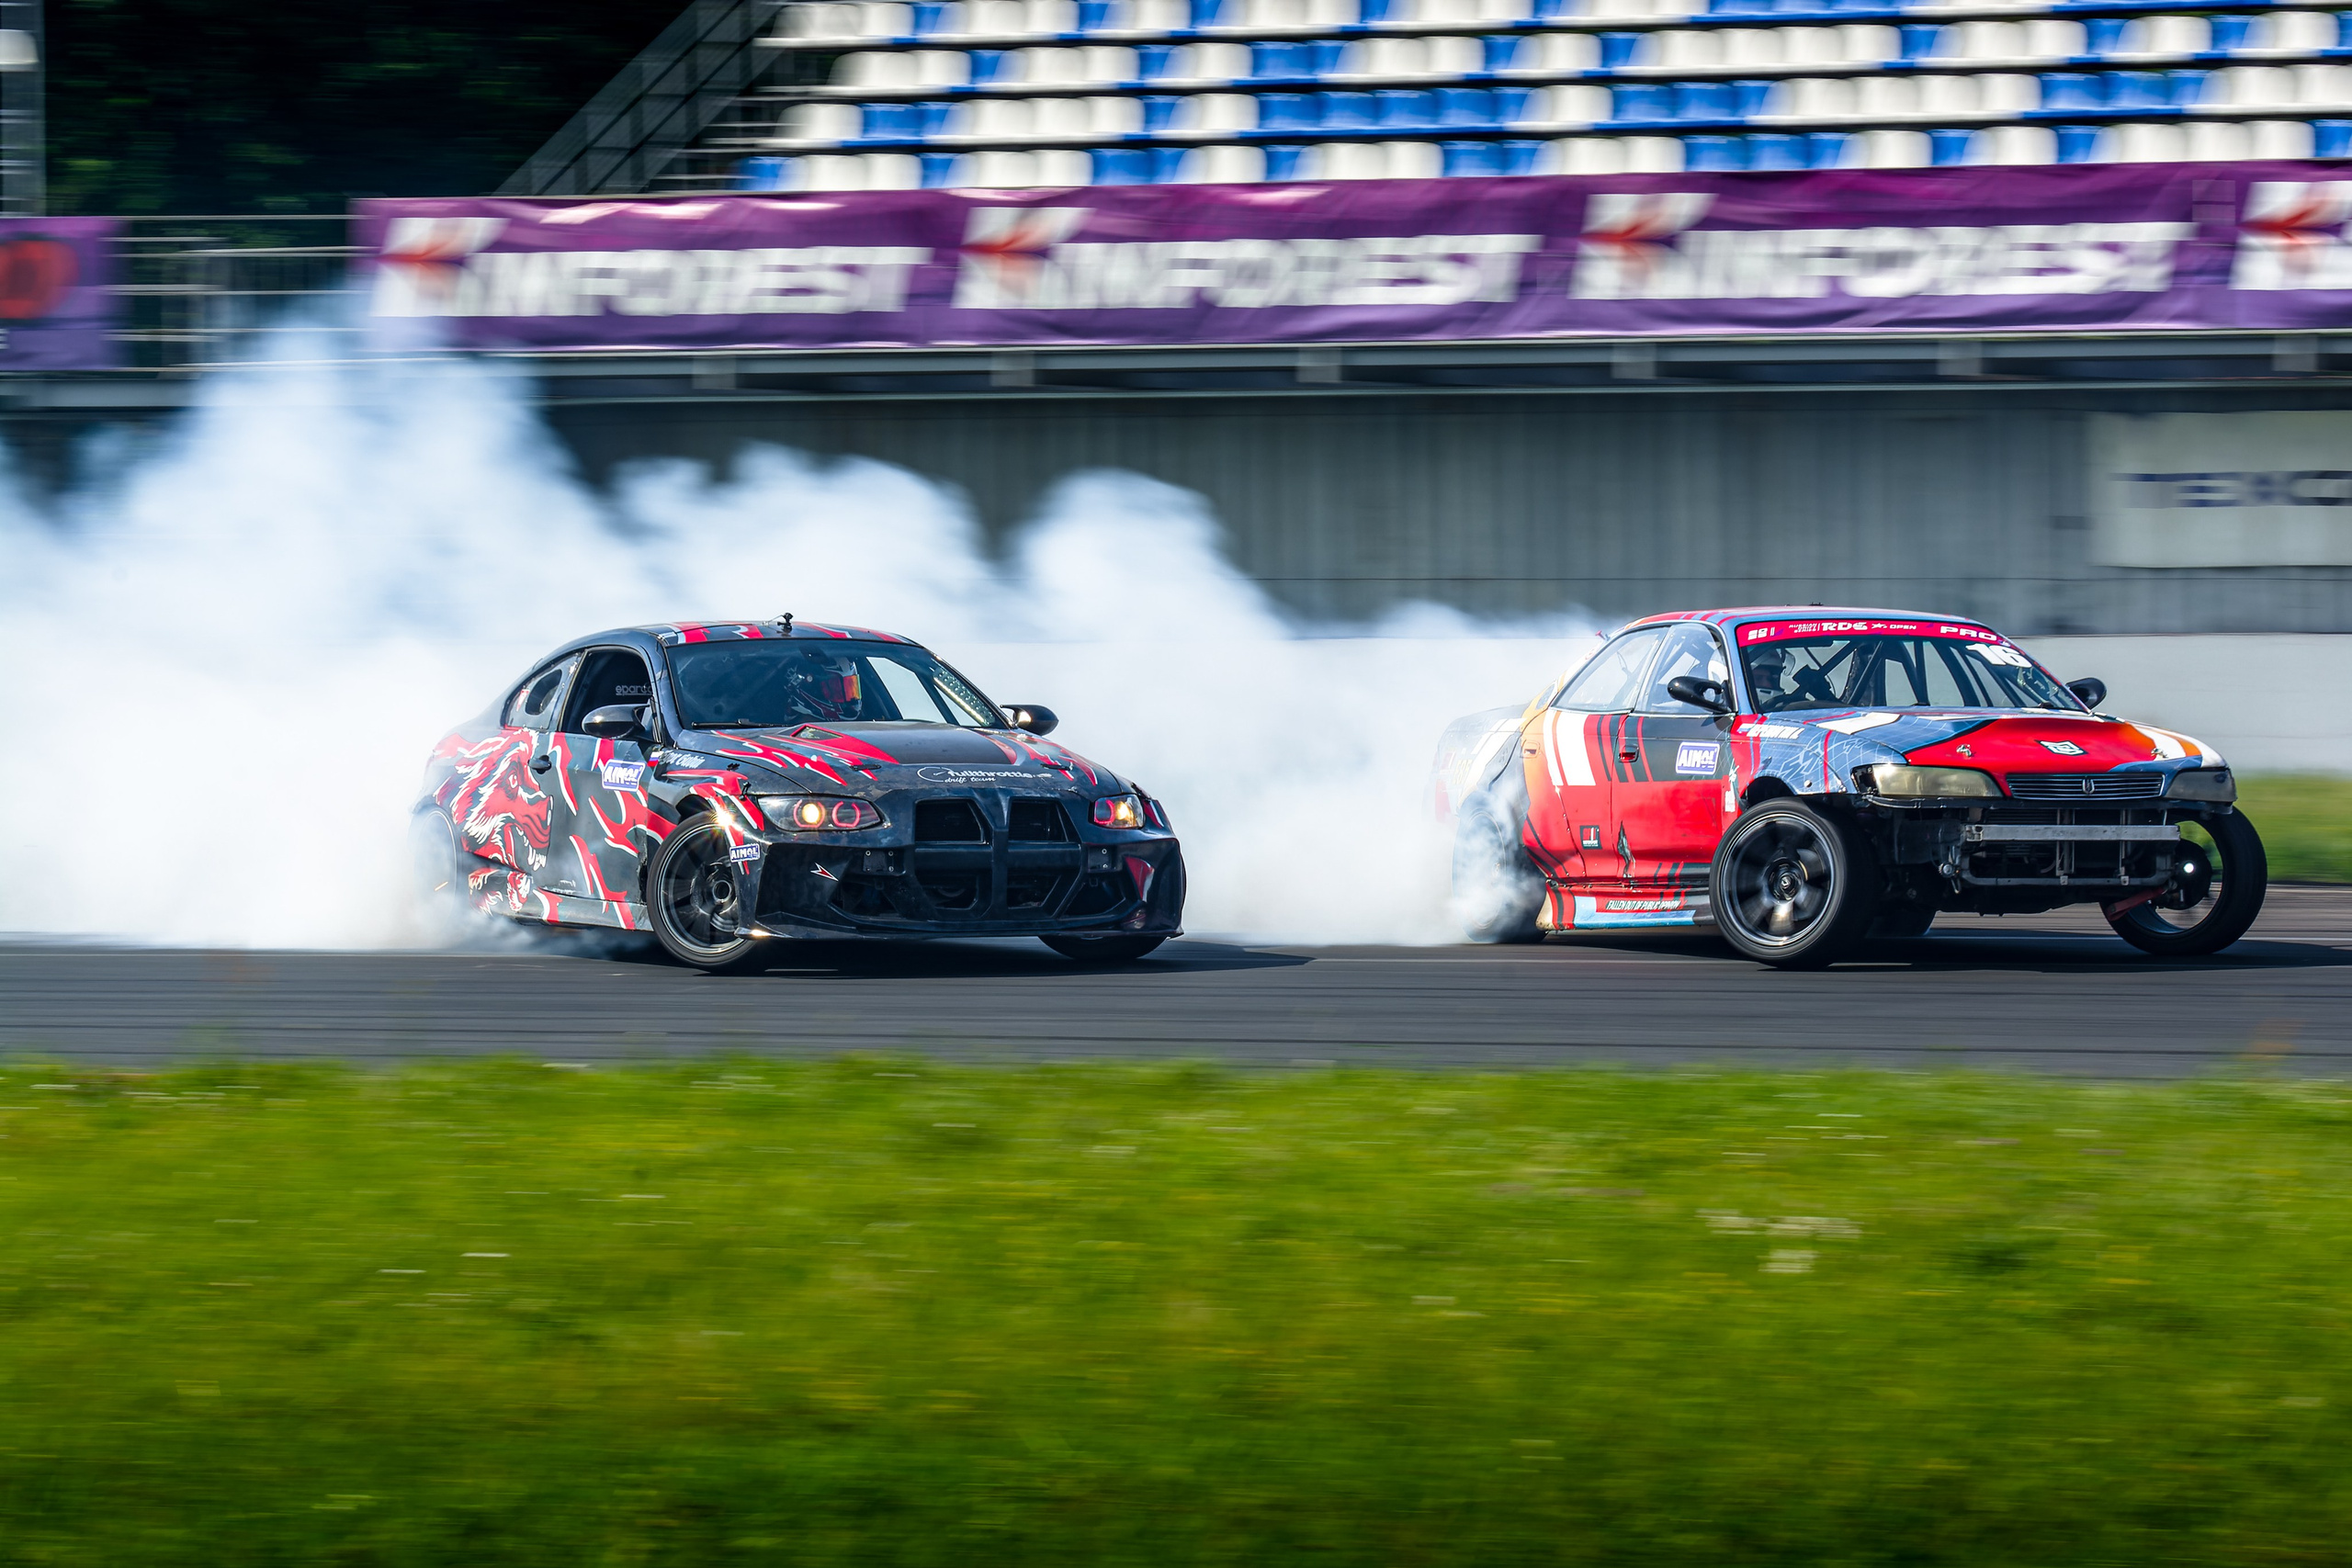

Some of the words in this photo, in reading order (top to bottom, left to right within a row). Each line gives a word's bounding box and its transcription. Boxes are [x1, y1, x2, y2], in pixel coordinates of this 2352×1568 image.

[1939, 626, 1997, 641] PRO
[1965, 643, 2033, 668] 16
[1678, 749, 1716, 768] AIMOL
[604, 765, 641, 785] AIMOL
[731, 846, 759, 860] AIMOL
[1606, 900, 1626, 909] FALLEN
[1623, 900, 1637, 909] OUT
